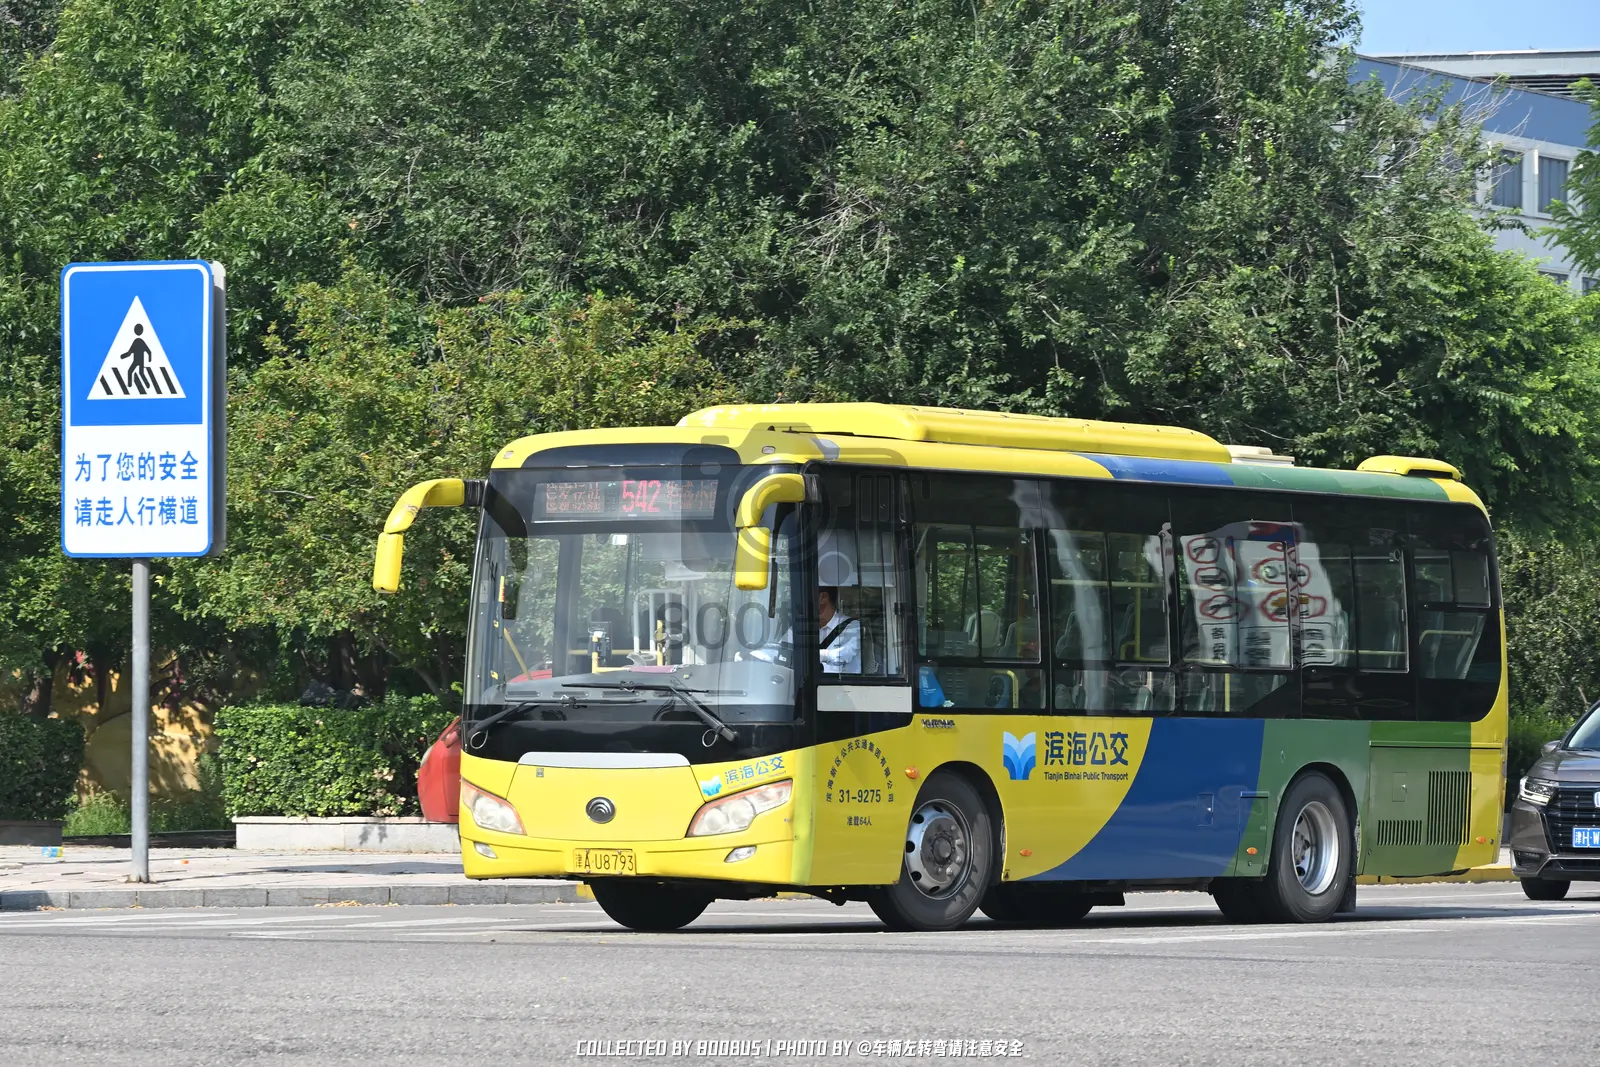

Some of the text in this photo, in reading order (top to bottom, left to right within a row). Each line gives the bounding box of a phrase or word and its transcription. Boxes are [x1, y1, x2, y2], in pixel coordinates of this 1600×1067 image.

[75, 450, 199, 482] 为了您的安全
[74, 496, 199, 527] 请走人行横道
[622, 480, 662, 512] 542
[1044, 731, 1129, 766] 滨海公交
[724, 755, 785, 785] 滨海公交
[1044, 772, 1129, 782] Tianjin Binhai Public Transport
[839, 789, 881, 803] 31-9275
